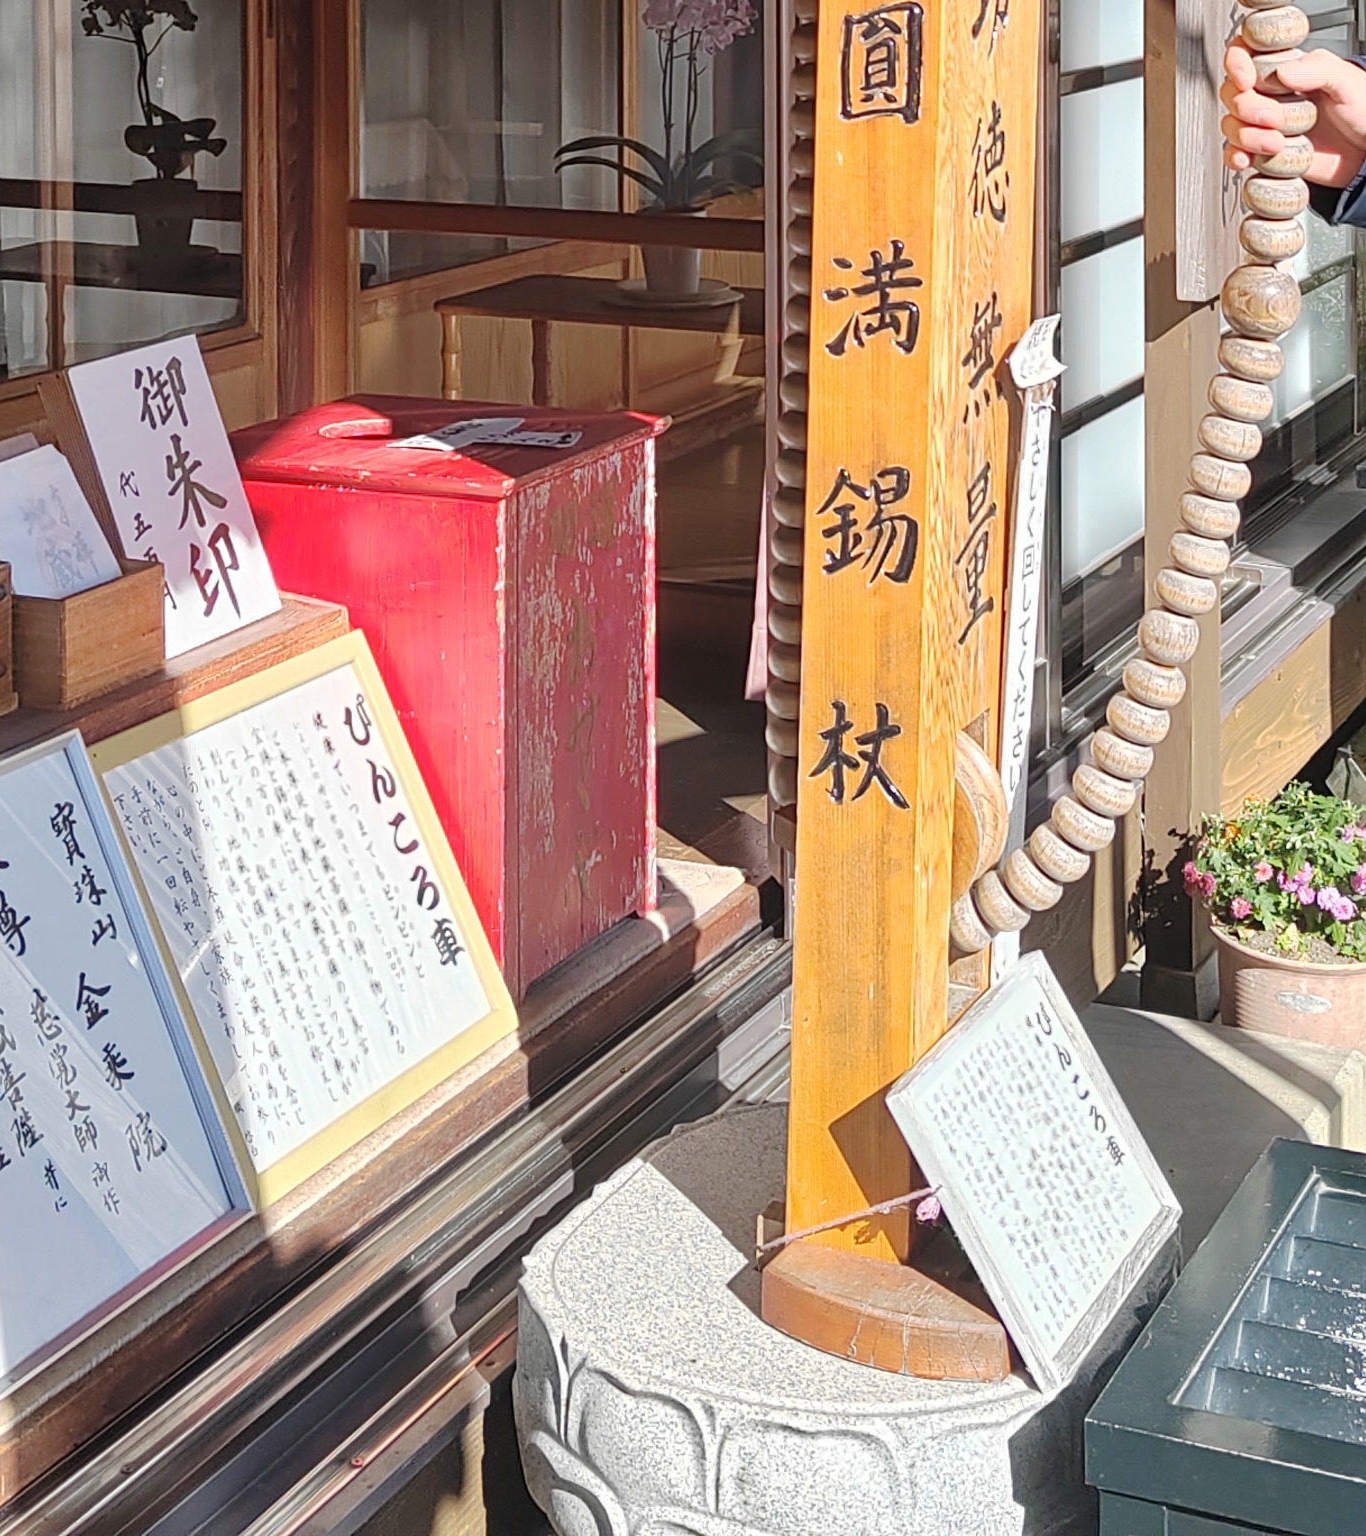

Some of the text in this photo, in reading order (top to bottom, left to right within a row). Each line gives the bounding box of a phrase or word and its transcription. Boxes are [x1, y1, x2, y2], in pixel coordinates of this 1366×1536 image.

[132, 355, 243, 620] 御朱印
[343, 692, 467, 969] ぴんころ車
[1036, 1001, 1126, 1167] ぴんころ車
